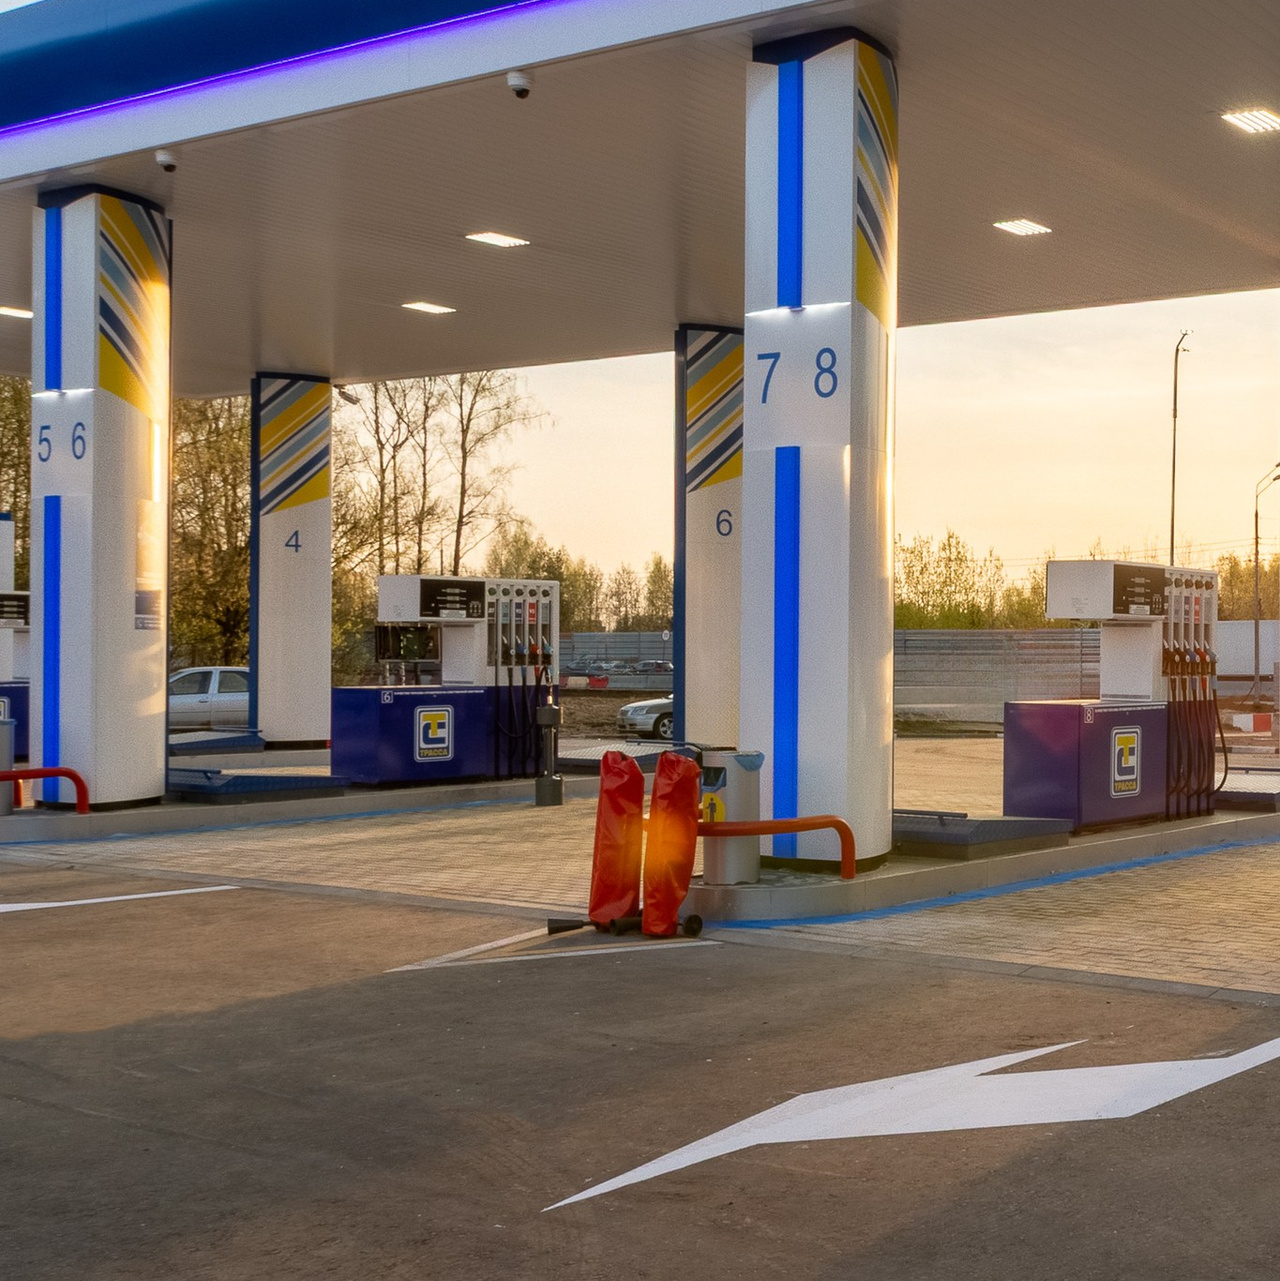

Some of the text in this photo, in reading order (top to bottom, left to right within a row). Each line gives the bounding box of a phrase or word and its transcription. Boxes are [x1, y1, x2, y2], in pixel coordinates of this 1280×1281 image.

[756, 347, 838, 405] 7 8
[37, 420, 87, 463] 5 6
[716, 509, 733, 537] 6
[284, 529, 302, 553] 4
[384, 691, 391, 702] 6
[1086, 708, 1092, 722] 8
[420, 749, 448, 757] ТРАССА
[1115, 781, 1136, 791] ТРАССА
